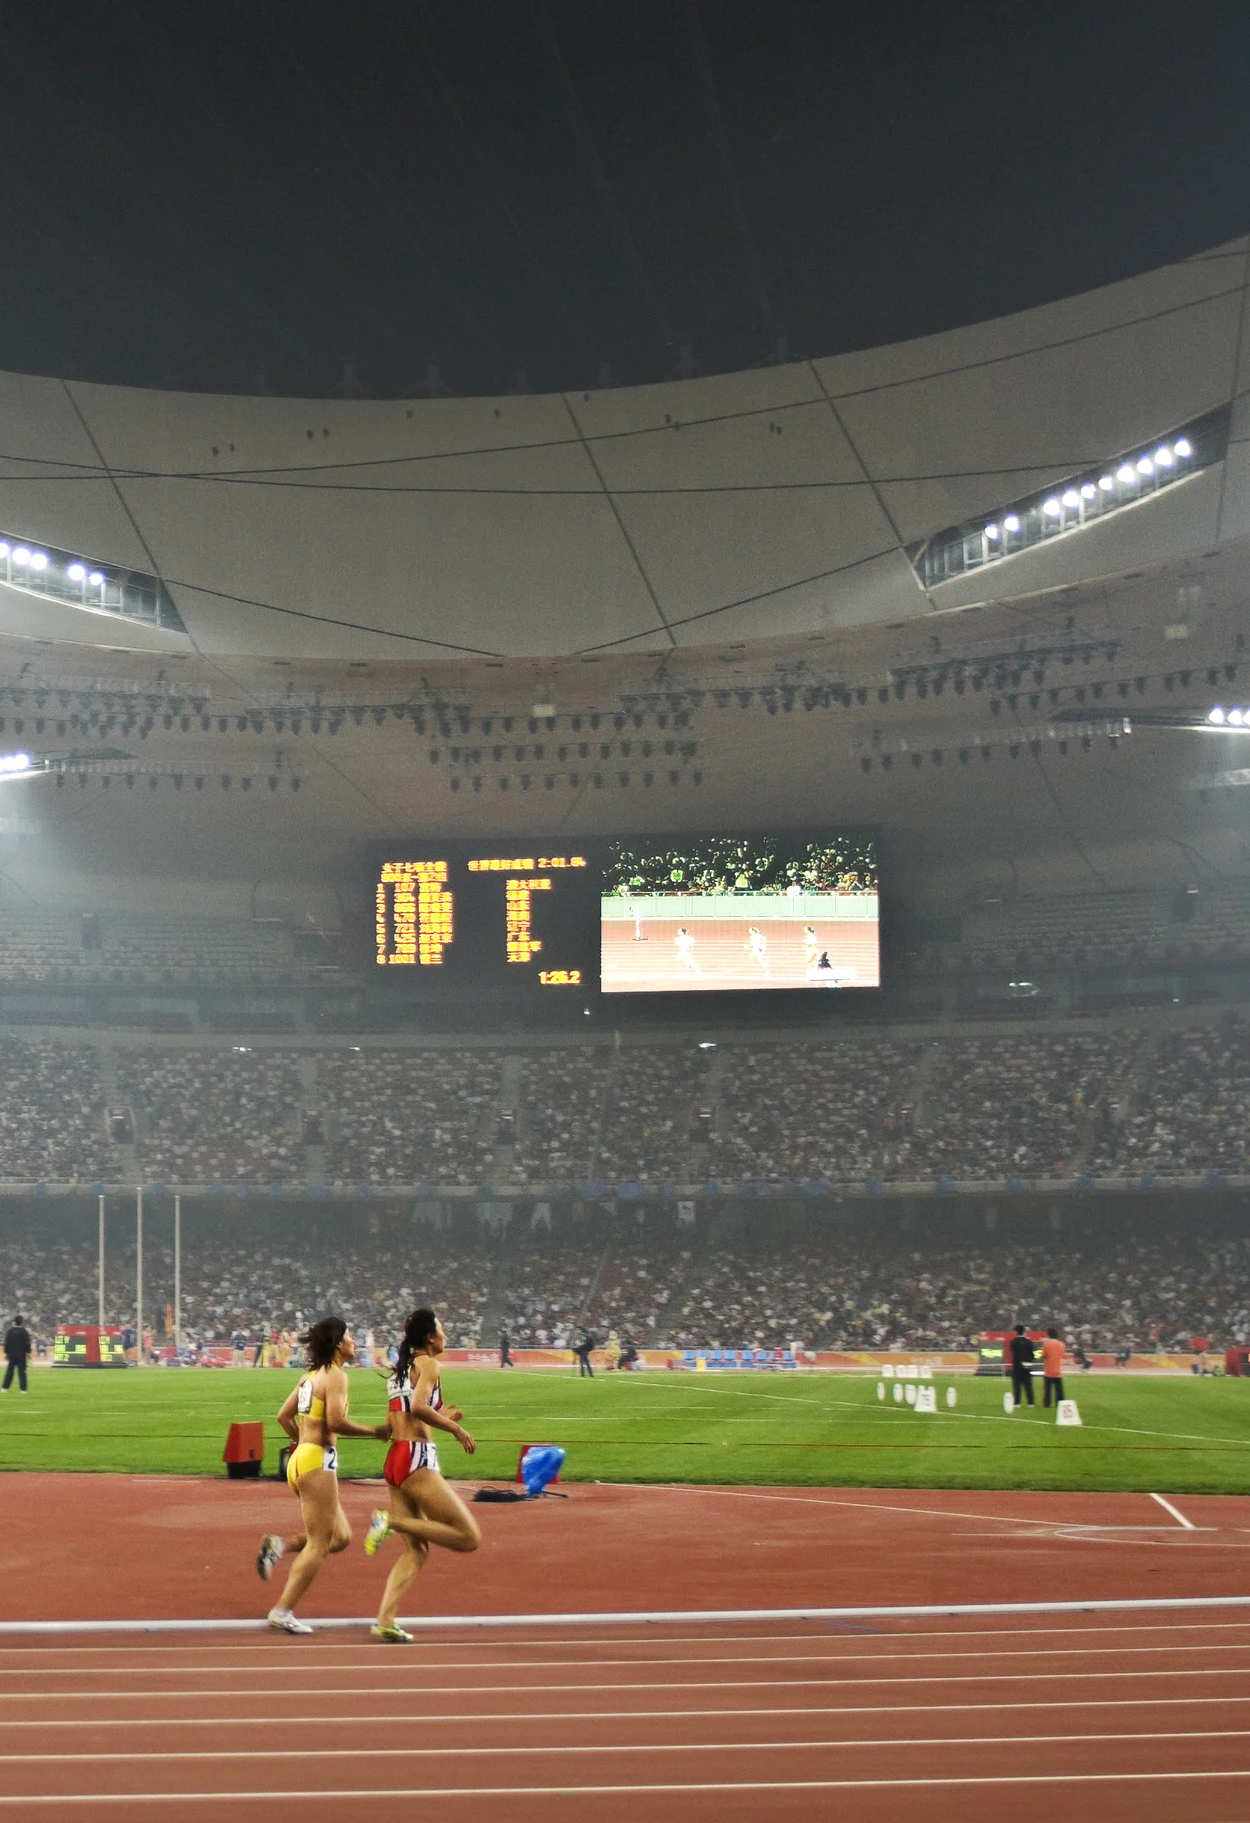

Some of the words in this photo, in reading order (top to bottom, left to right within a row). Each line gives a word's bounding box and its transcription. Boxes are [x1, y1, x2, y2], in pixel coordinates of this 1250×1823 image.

[376, 884, 385, 893] 1
[376, 894, 385, 903] 2
[376, 904, 385, 913] 3
[376, 914, 385, 923] 4
[376, 924, 385, 933] 5
[376, 934, 385, 943] 6
[376, 944, 385, 954] 7
[376, 954, 385, 964] 8
[538, 970, 581, 984] 1:26.2
[328, 1448, 335, 1469] 2
